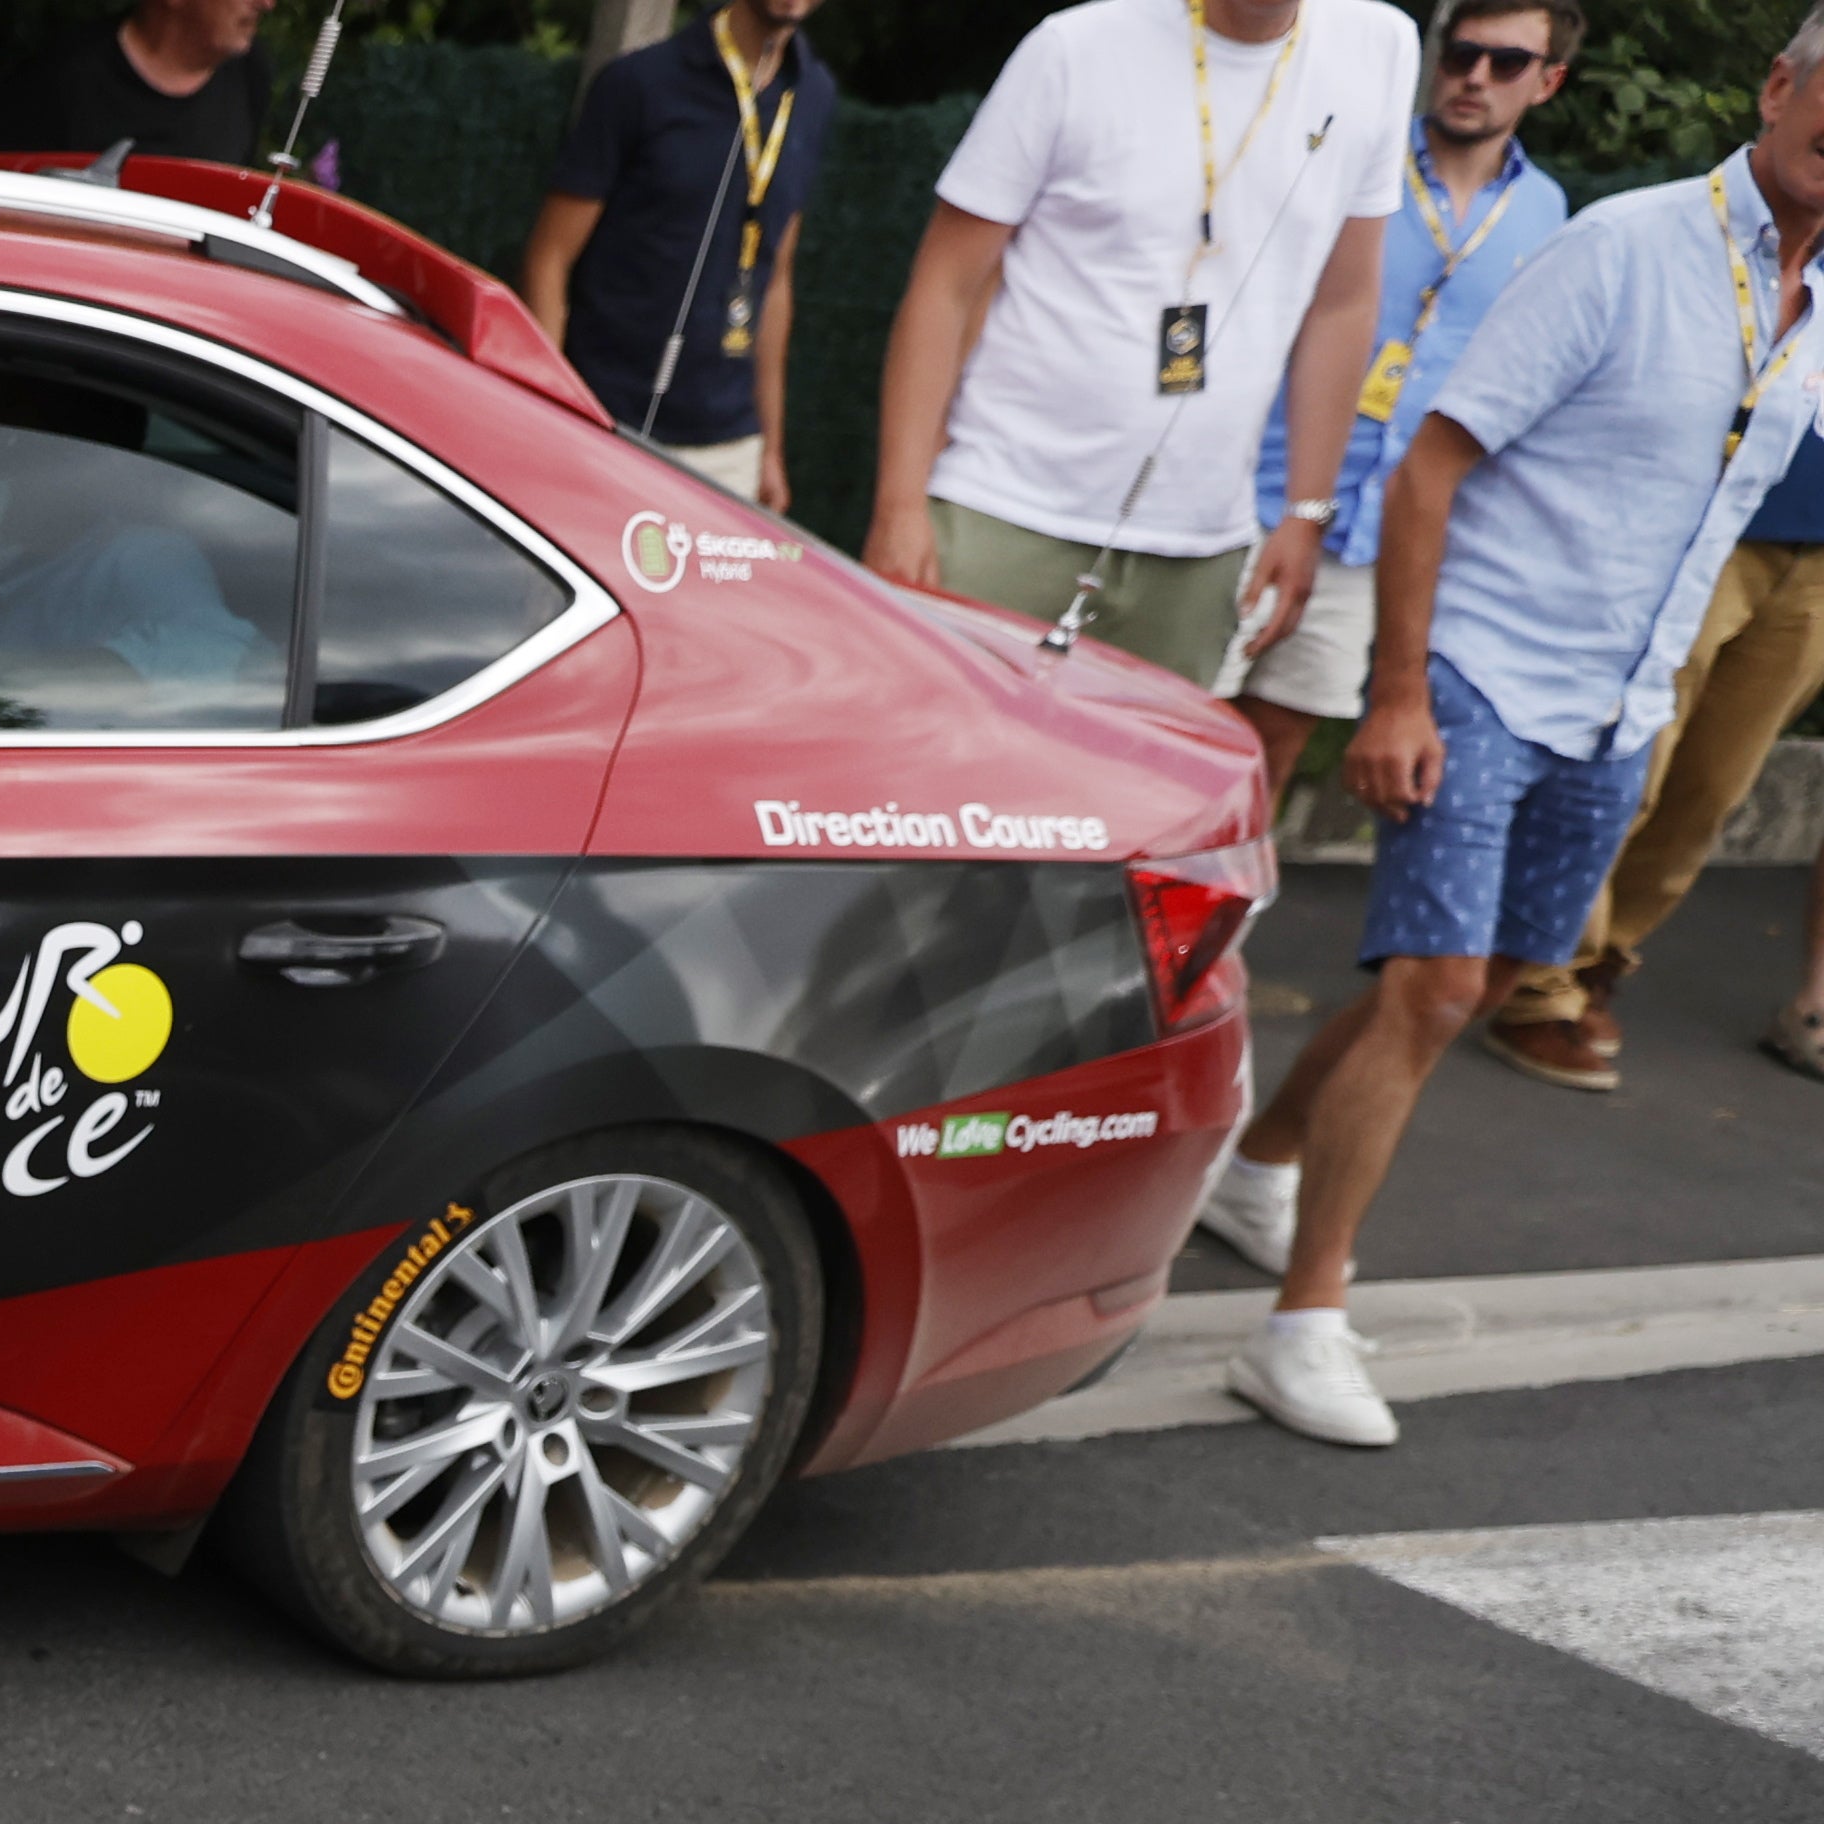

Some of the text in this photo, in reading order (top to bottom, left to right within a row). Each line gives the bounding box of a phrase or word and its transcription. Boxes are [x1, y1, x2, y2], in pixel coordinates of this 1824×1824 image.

[754, 800, 1109, 851] Direction Course
[5, 1052, 69, 1120] de
[897, 1123, 936, 1158] We
[1006, 1110, 1158, 1151] Cycling.com
